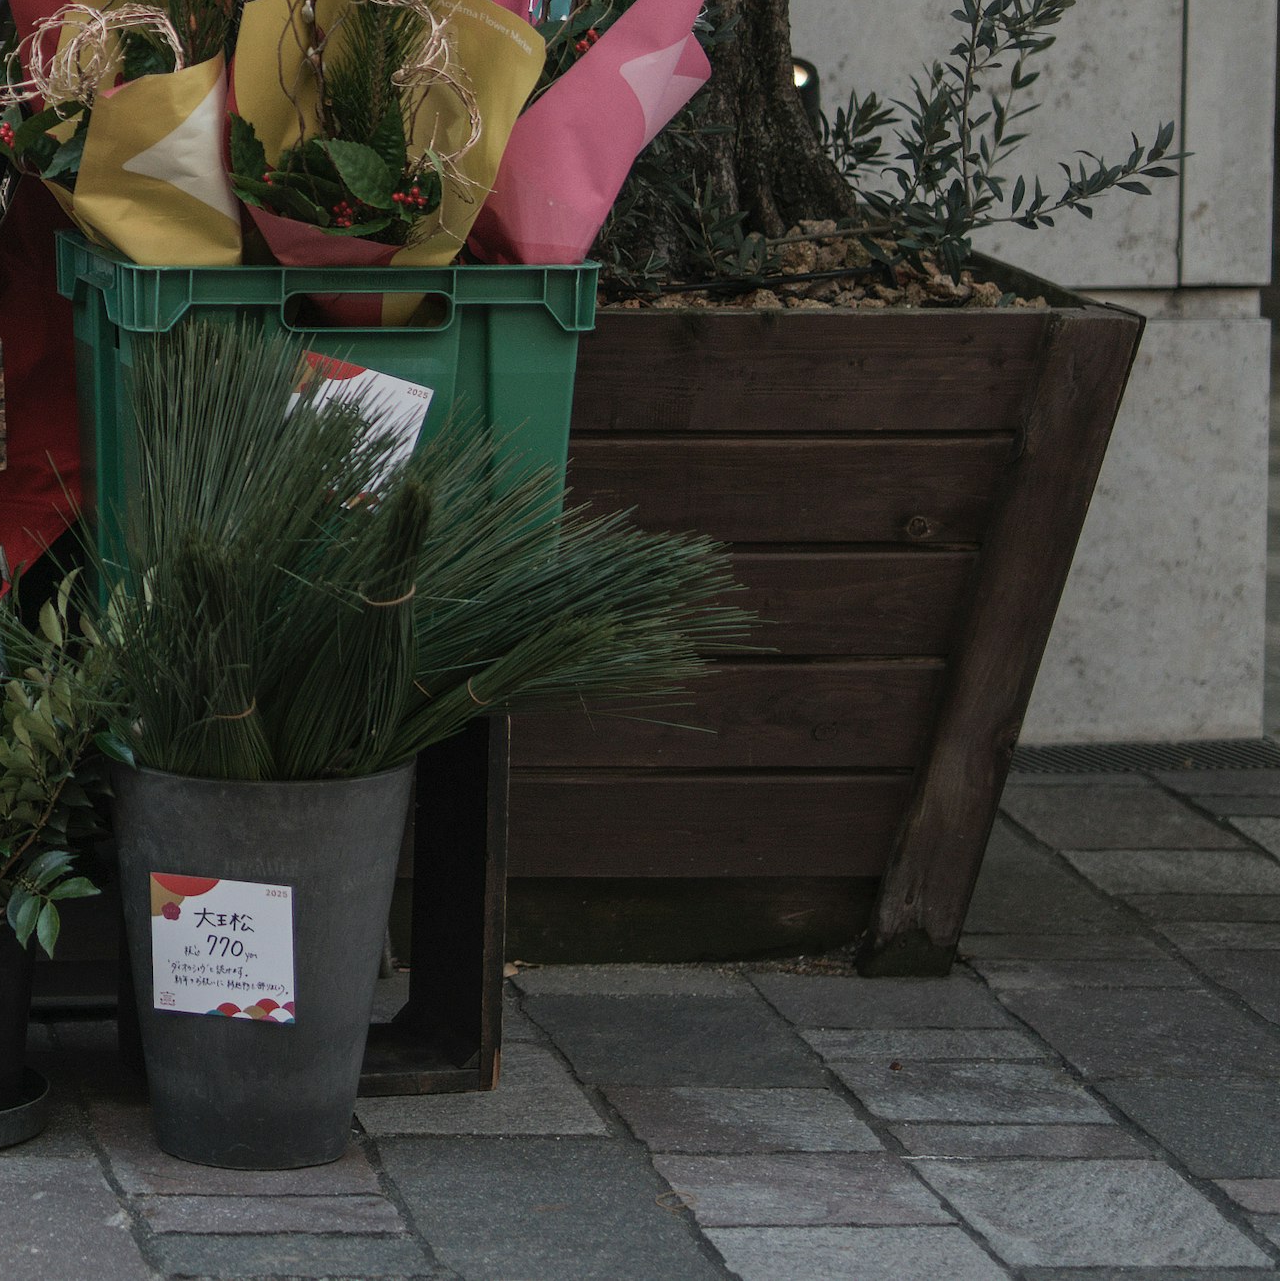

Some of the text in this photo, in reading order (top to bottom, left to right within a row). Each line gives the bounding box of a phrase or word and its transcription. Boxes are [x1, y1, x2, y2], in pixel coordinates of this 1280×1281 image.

[479, 12, 510, 36] Flower
[407, 387, 429, 399] 2025
[265, 888, 288, 899] 2025
[193, 907, 255, 933] 大王松
[206, 934, 244, 958] 770
[244, 951, 258, 963] yen
